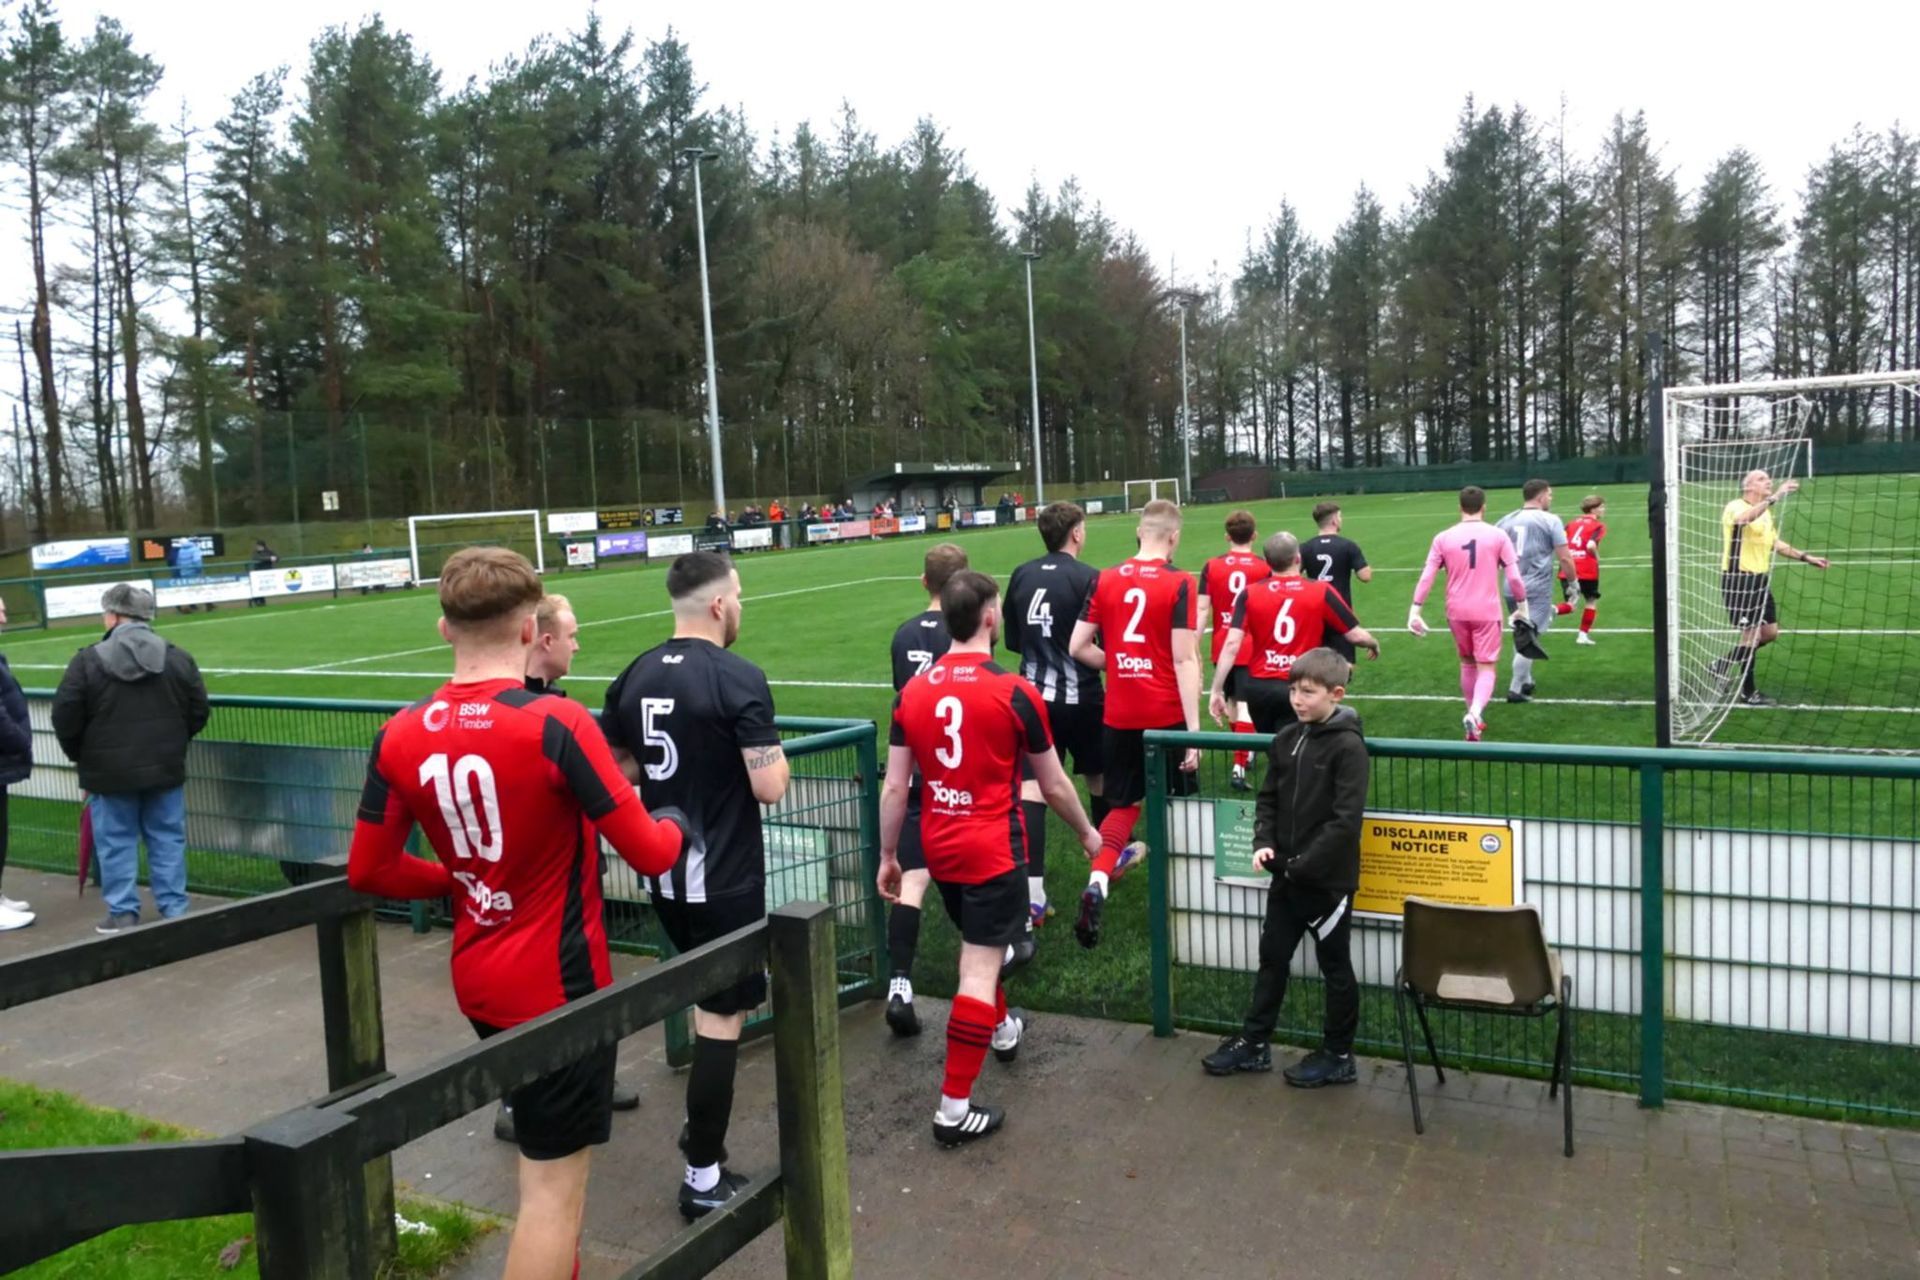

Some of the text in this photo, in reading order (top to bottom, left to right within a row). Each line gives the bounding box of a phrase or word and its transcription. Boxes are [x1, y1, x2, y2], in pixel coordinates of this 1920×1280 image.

[1512, 525, 1527, 557] 1
[1571, 525, 1583, 547] 4
[1317, 553, 1333, 582] 2
[1461, 539, 1477, 569] 1
[1228, 570, 1246, 607] 9
[1027, 588, 1053, 638] 4
[1123, 588, 1147, 643] 2
[1273, 598, 1296, 645] 6
[907, 650, 934, 676] 7
[458, 717, 494, 730] Timber
[459, 703, 491, 716] BSW
[641, 697, 679, 781] 5
[934, 695, 963, 769] 3
[418, 752, 503, 863] 10
[1372, 826, 1468, 842] DISCLAIMER
[1391, 841, 1449, 854] NOTICE
